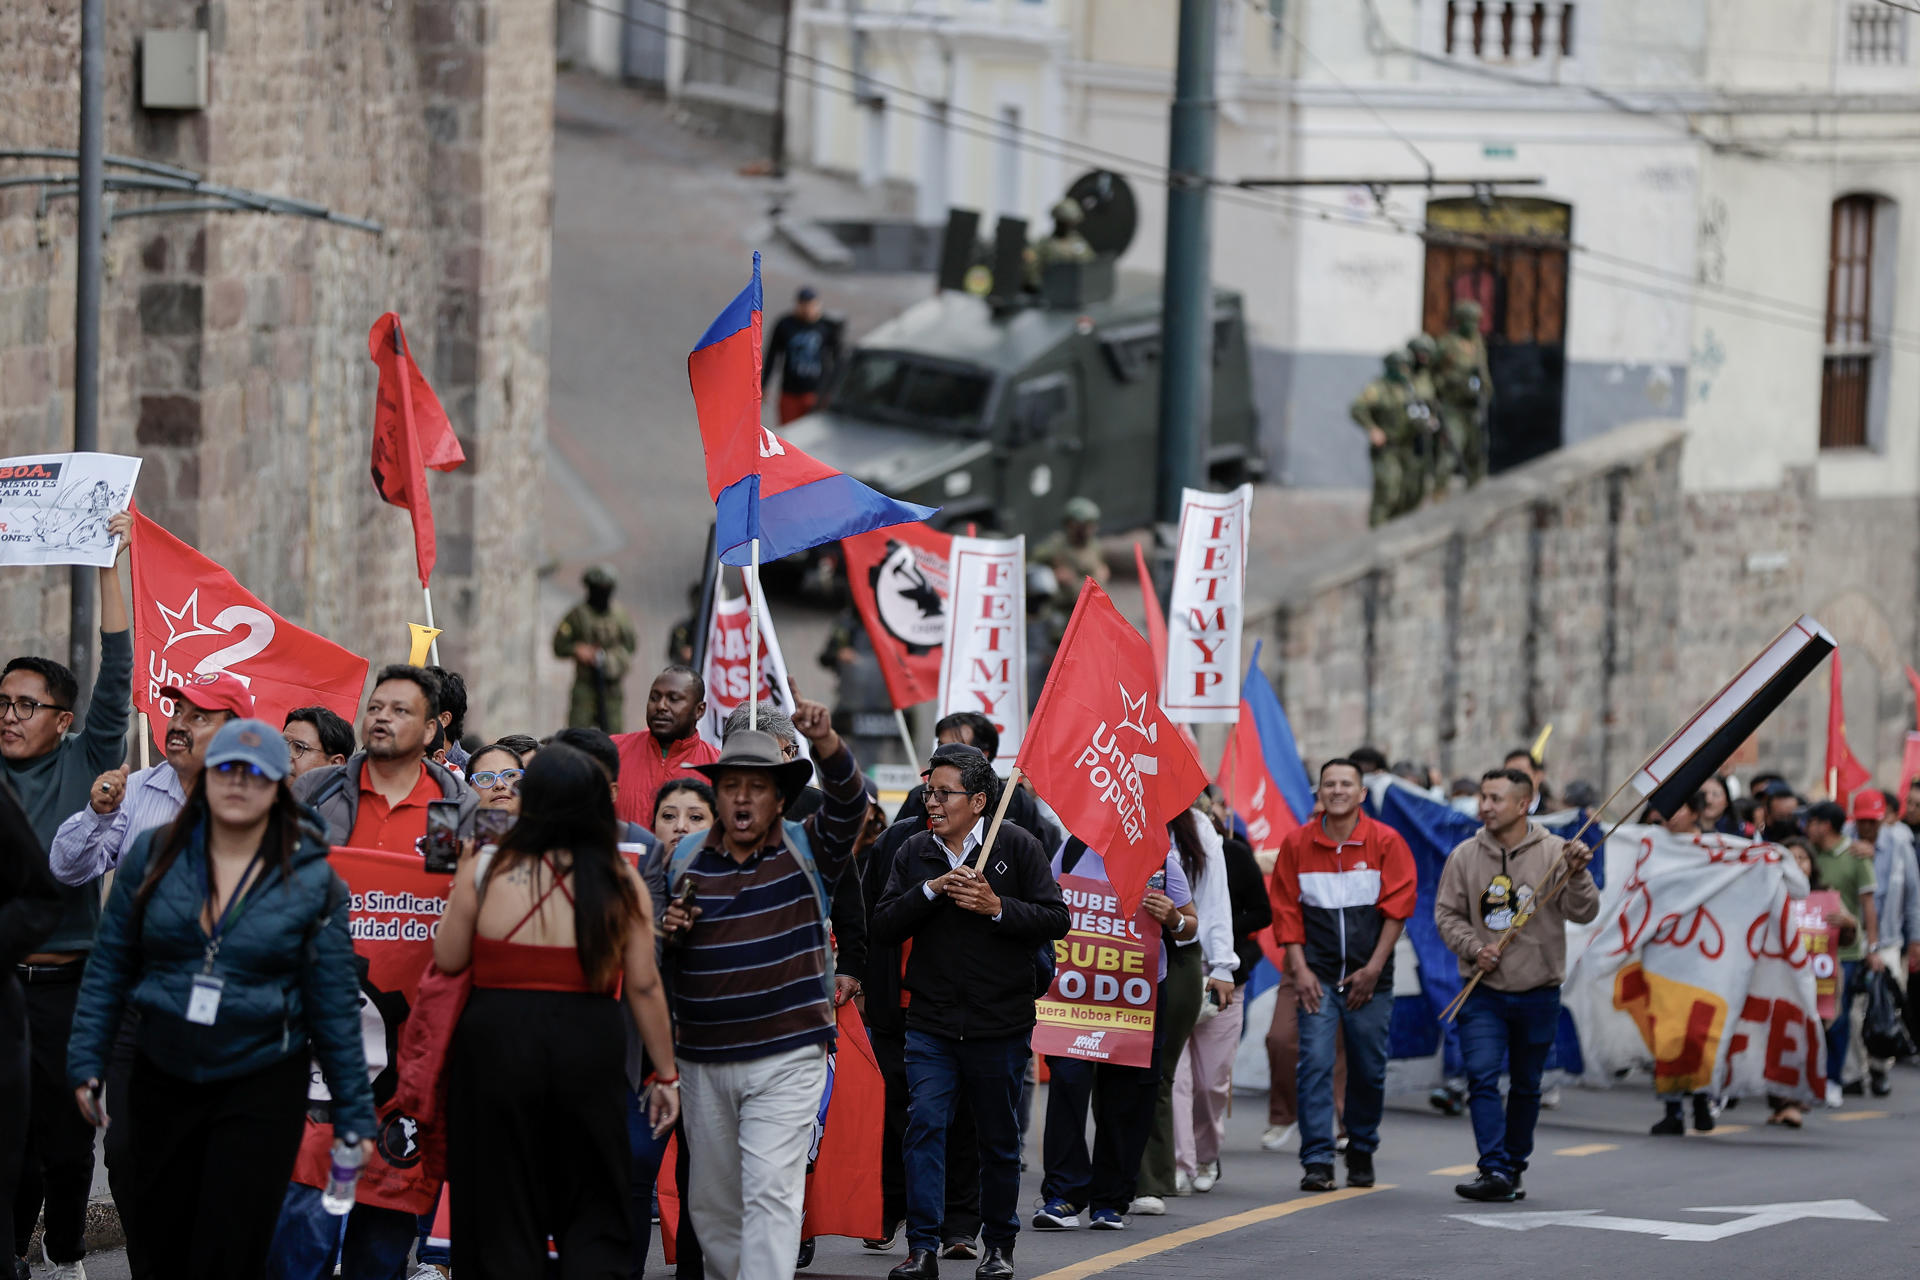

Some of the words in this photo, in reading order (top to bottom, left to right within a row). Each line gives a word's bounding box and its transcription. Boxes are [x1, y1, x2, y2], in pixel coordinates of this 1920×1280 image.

[24, 489, 42, 497] AL
[42, 480, 57, 488] ES
[1, 534, 32, 543] ONES
[1188, 512, 1235, 699] FETMYP
[1074, 746, 1144, 847] Popular
[1062, 888, 1118, 913] SUBE
[403, 918, 428, 940] de
[1069, 911, 1143, 940] IÉSEL
[1054, 940, 1145, 974] SUBE
[1055, 968, 1152, 1006] ODO
[1071, 1007, 1111, 1022] Noboa
[1115, 1011, 1152, 1025] Fuera
